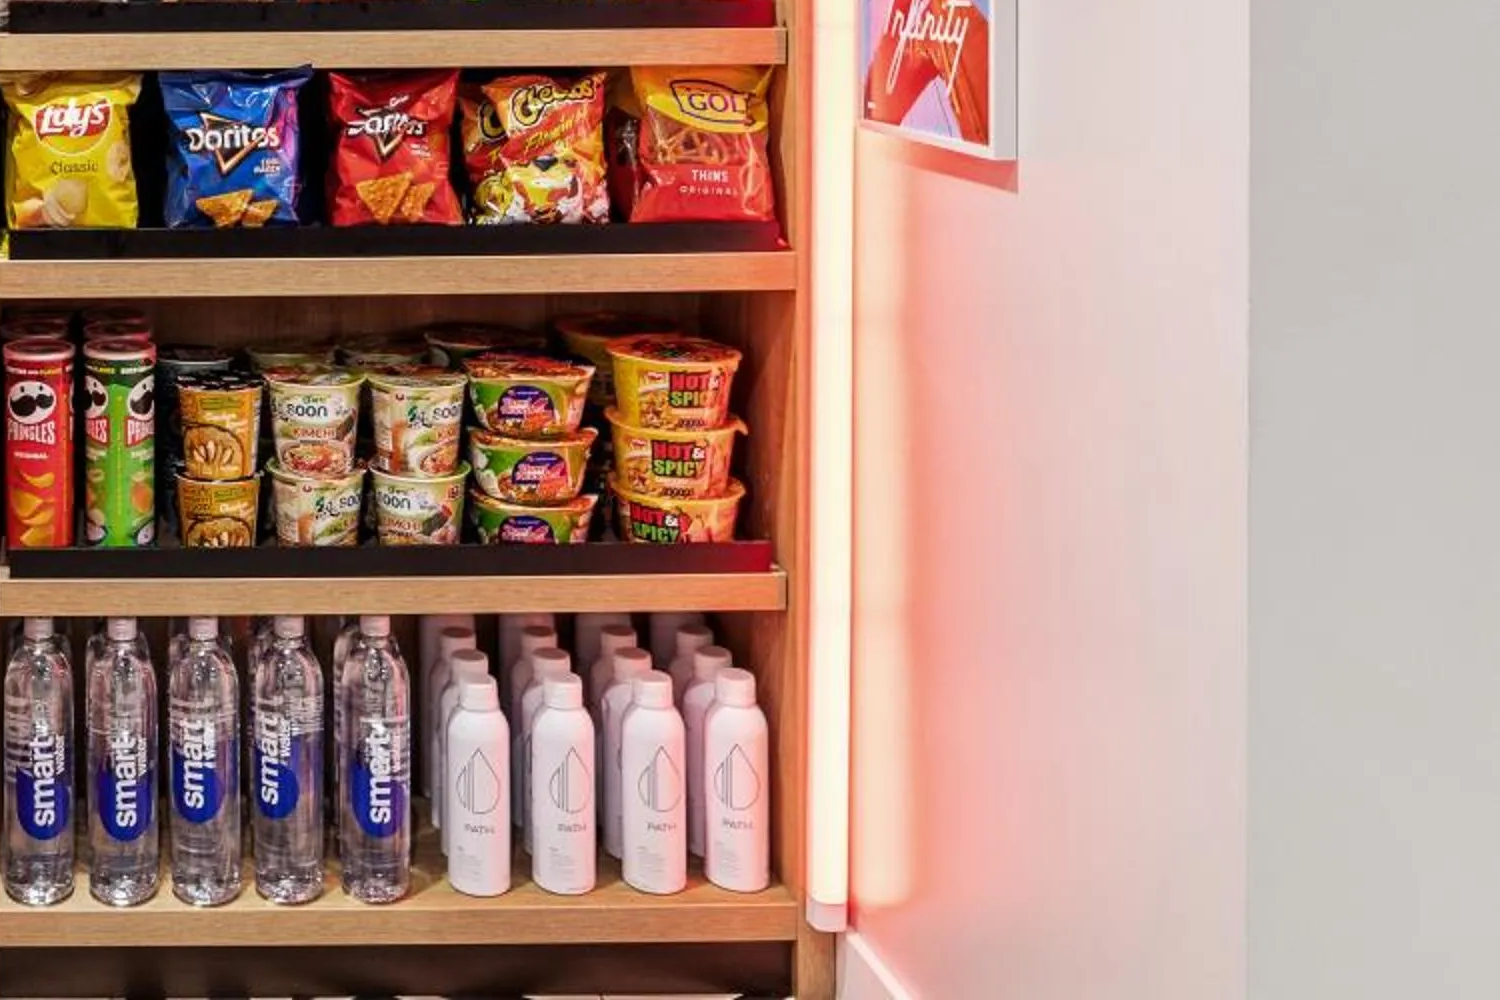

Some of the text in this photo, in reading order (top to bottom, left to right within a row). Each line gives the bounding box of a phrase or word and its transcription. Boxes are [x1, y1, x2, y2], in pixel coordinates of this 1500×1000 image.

[186, 125, 281, 151] Doritos
[50, 157, 100, 175] Classic
[691, 169, 729, 183] THINS
[679, 185, 738, 197] ORIGINAL
[670, 372, 709, 392] HOT
[7, 419, 56, 445] PRINGLES
[652, 441, 692, 461] HOT
[179, 716, 205, 810] smart
[256, 697, 284, 807] smart
[27, 733, 56, 828] smart
[111, 732, 137, 829] smart
[365, 722, 392, 825] smart
